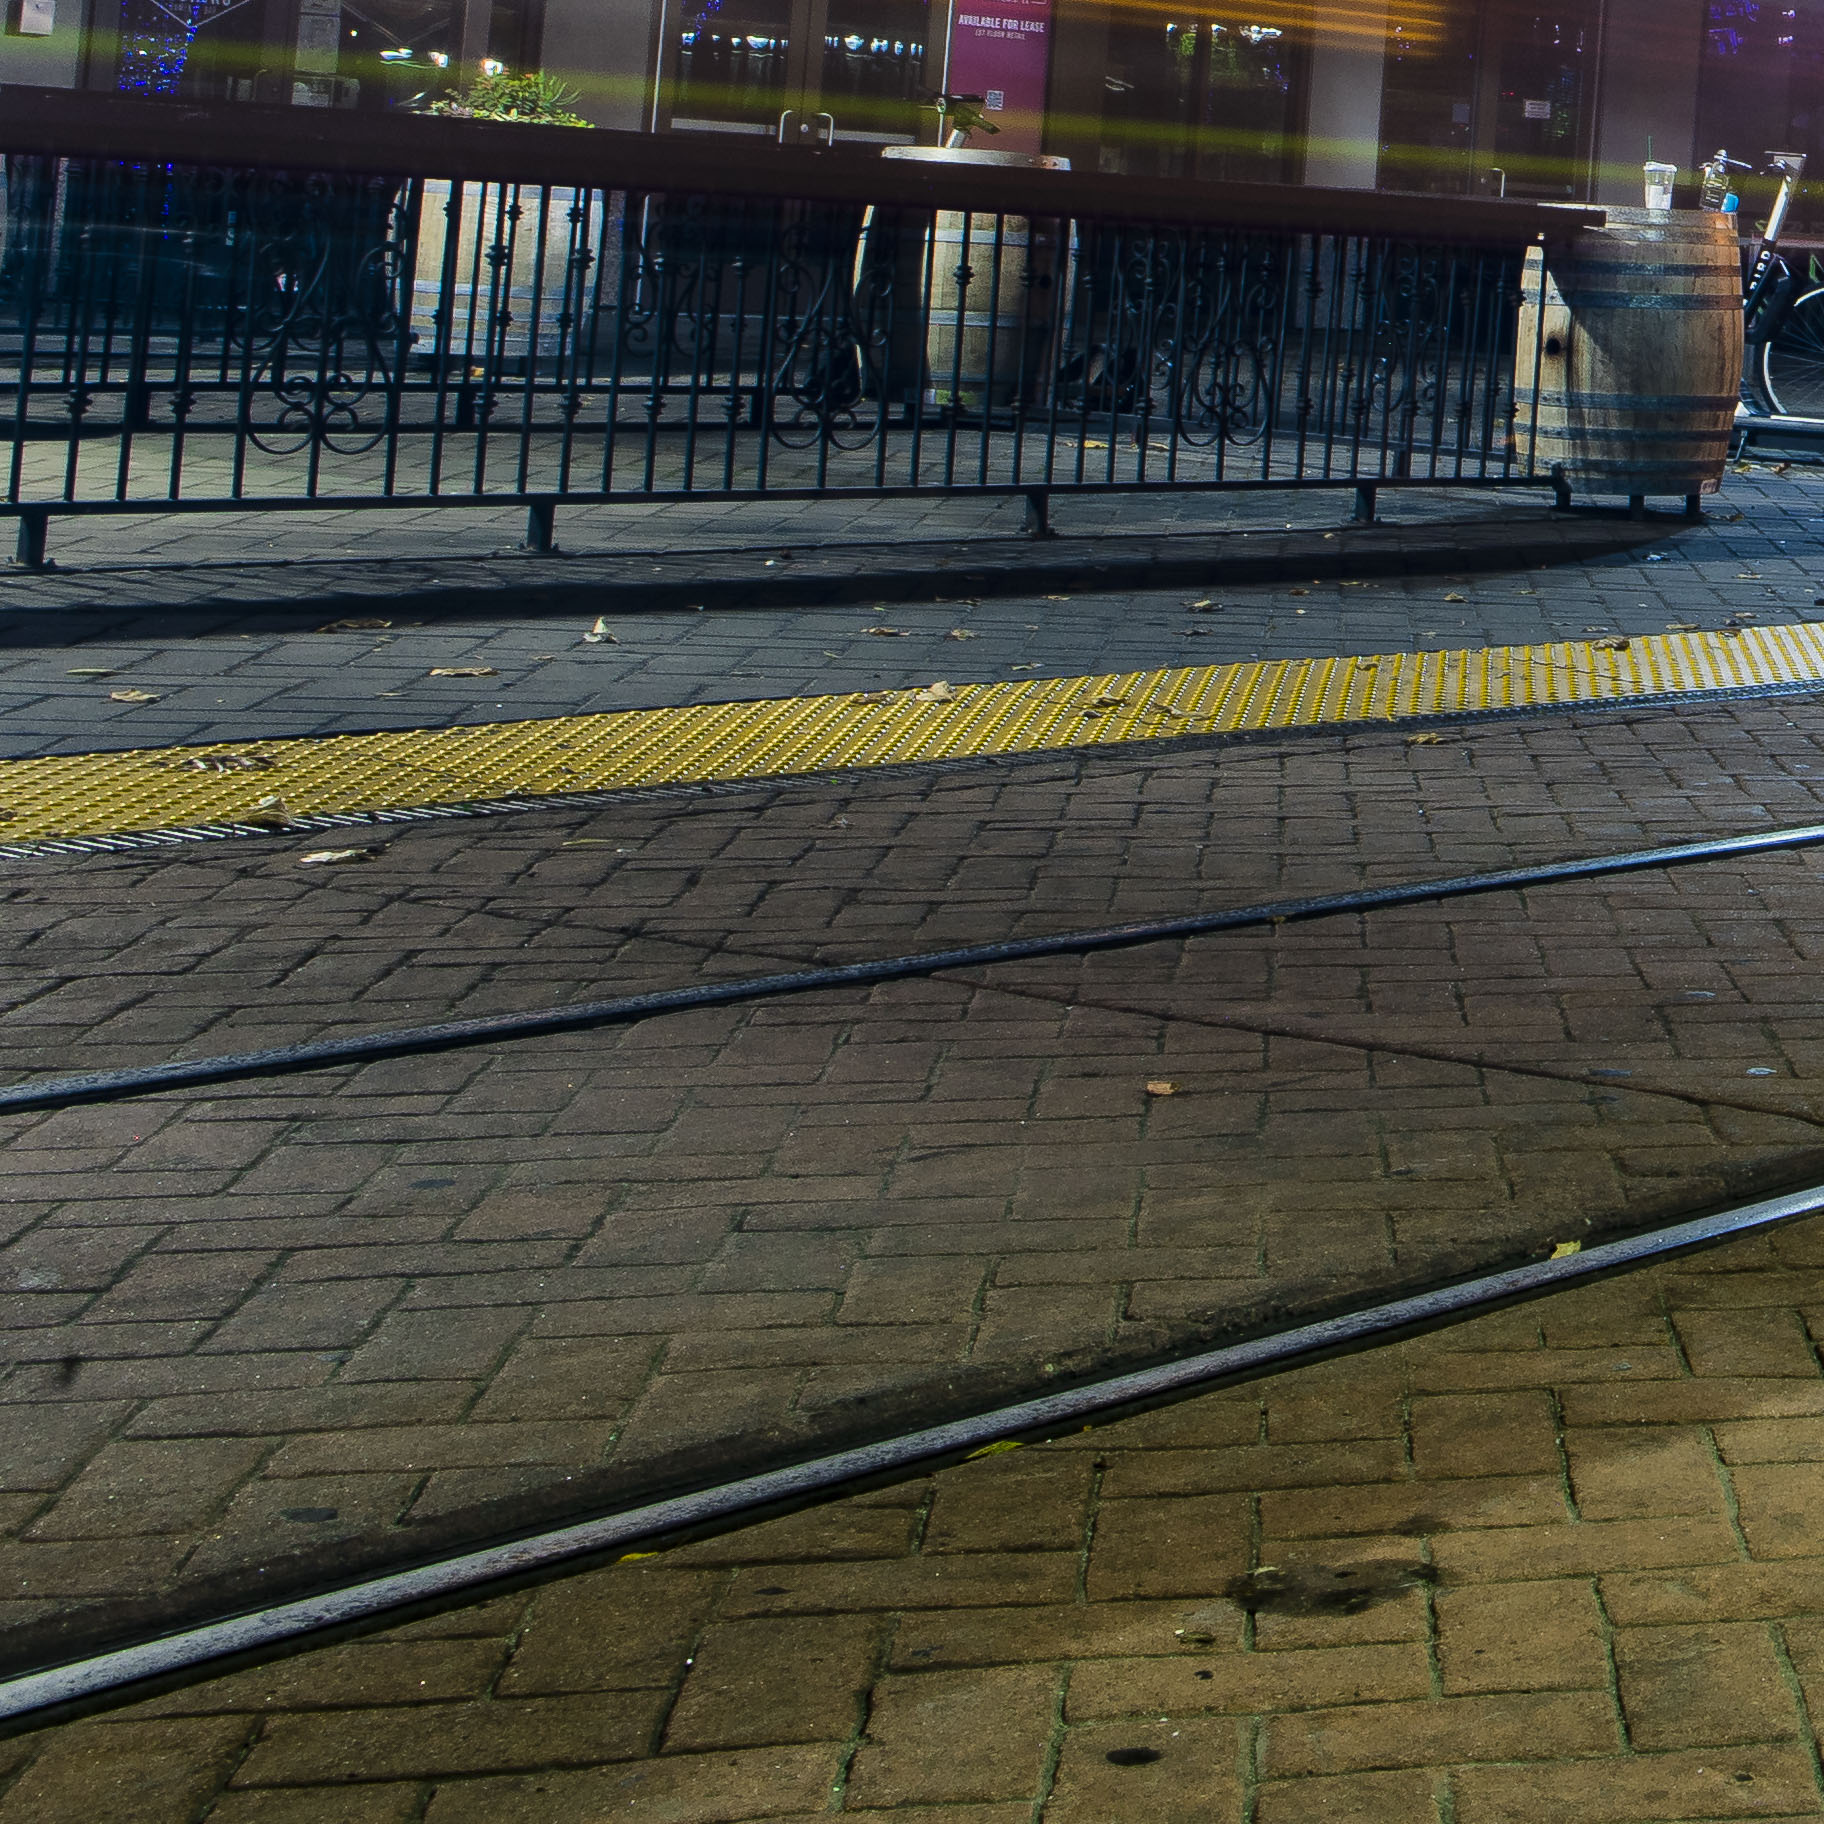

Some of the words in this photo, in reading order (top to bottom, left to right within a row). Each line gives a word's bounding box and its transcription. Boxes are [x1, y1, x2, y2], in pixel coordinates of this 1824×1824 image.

[958, 15, 1000, 29] AVAILABLE
[1002, 18, 1019, 31] FOR
[1020, 21, 1045, 33] LEASE
